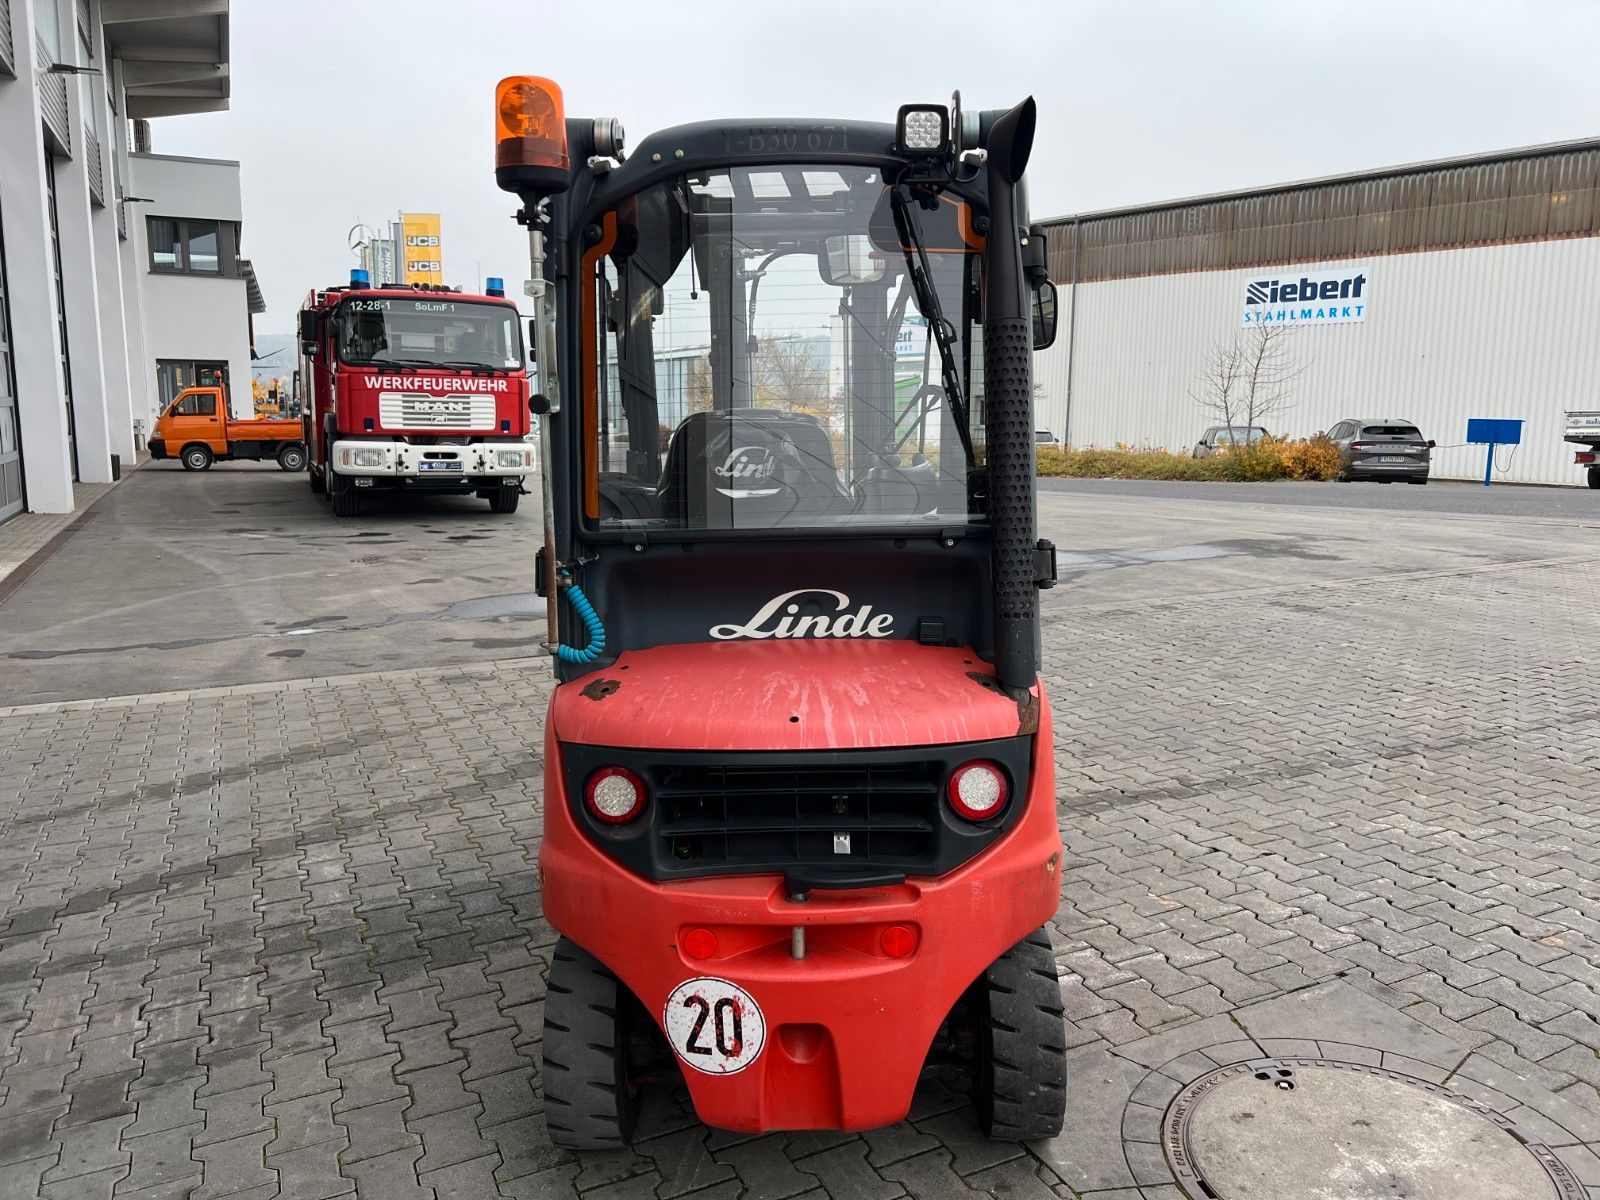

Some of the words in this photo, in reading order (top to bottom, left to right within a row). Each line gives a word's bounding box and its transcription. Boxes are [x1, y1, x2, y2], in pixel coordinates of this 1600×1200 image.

[407, 236, 439, 247] JCB
[409, 261, 440, 272] JCB
[1246, 274, 1366, 305] Siebert
[349, 301, 391, 311] 12-28-1
[450, 304, 455, 312] 1
[1244, 305, 1364, 322] STAHLMARKT
[364, 375, 509, 392] WERKFEUERWEHR
[414, 402, 463, 412] MAN
[709, 588, 894, 640] Linde
[683, 995, 743, 1058] 20
